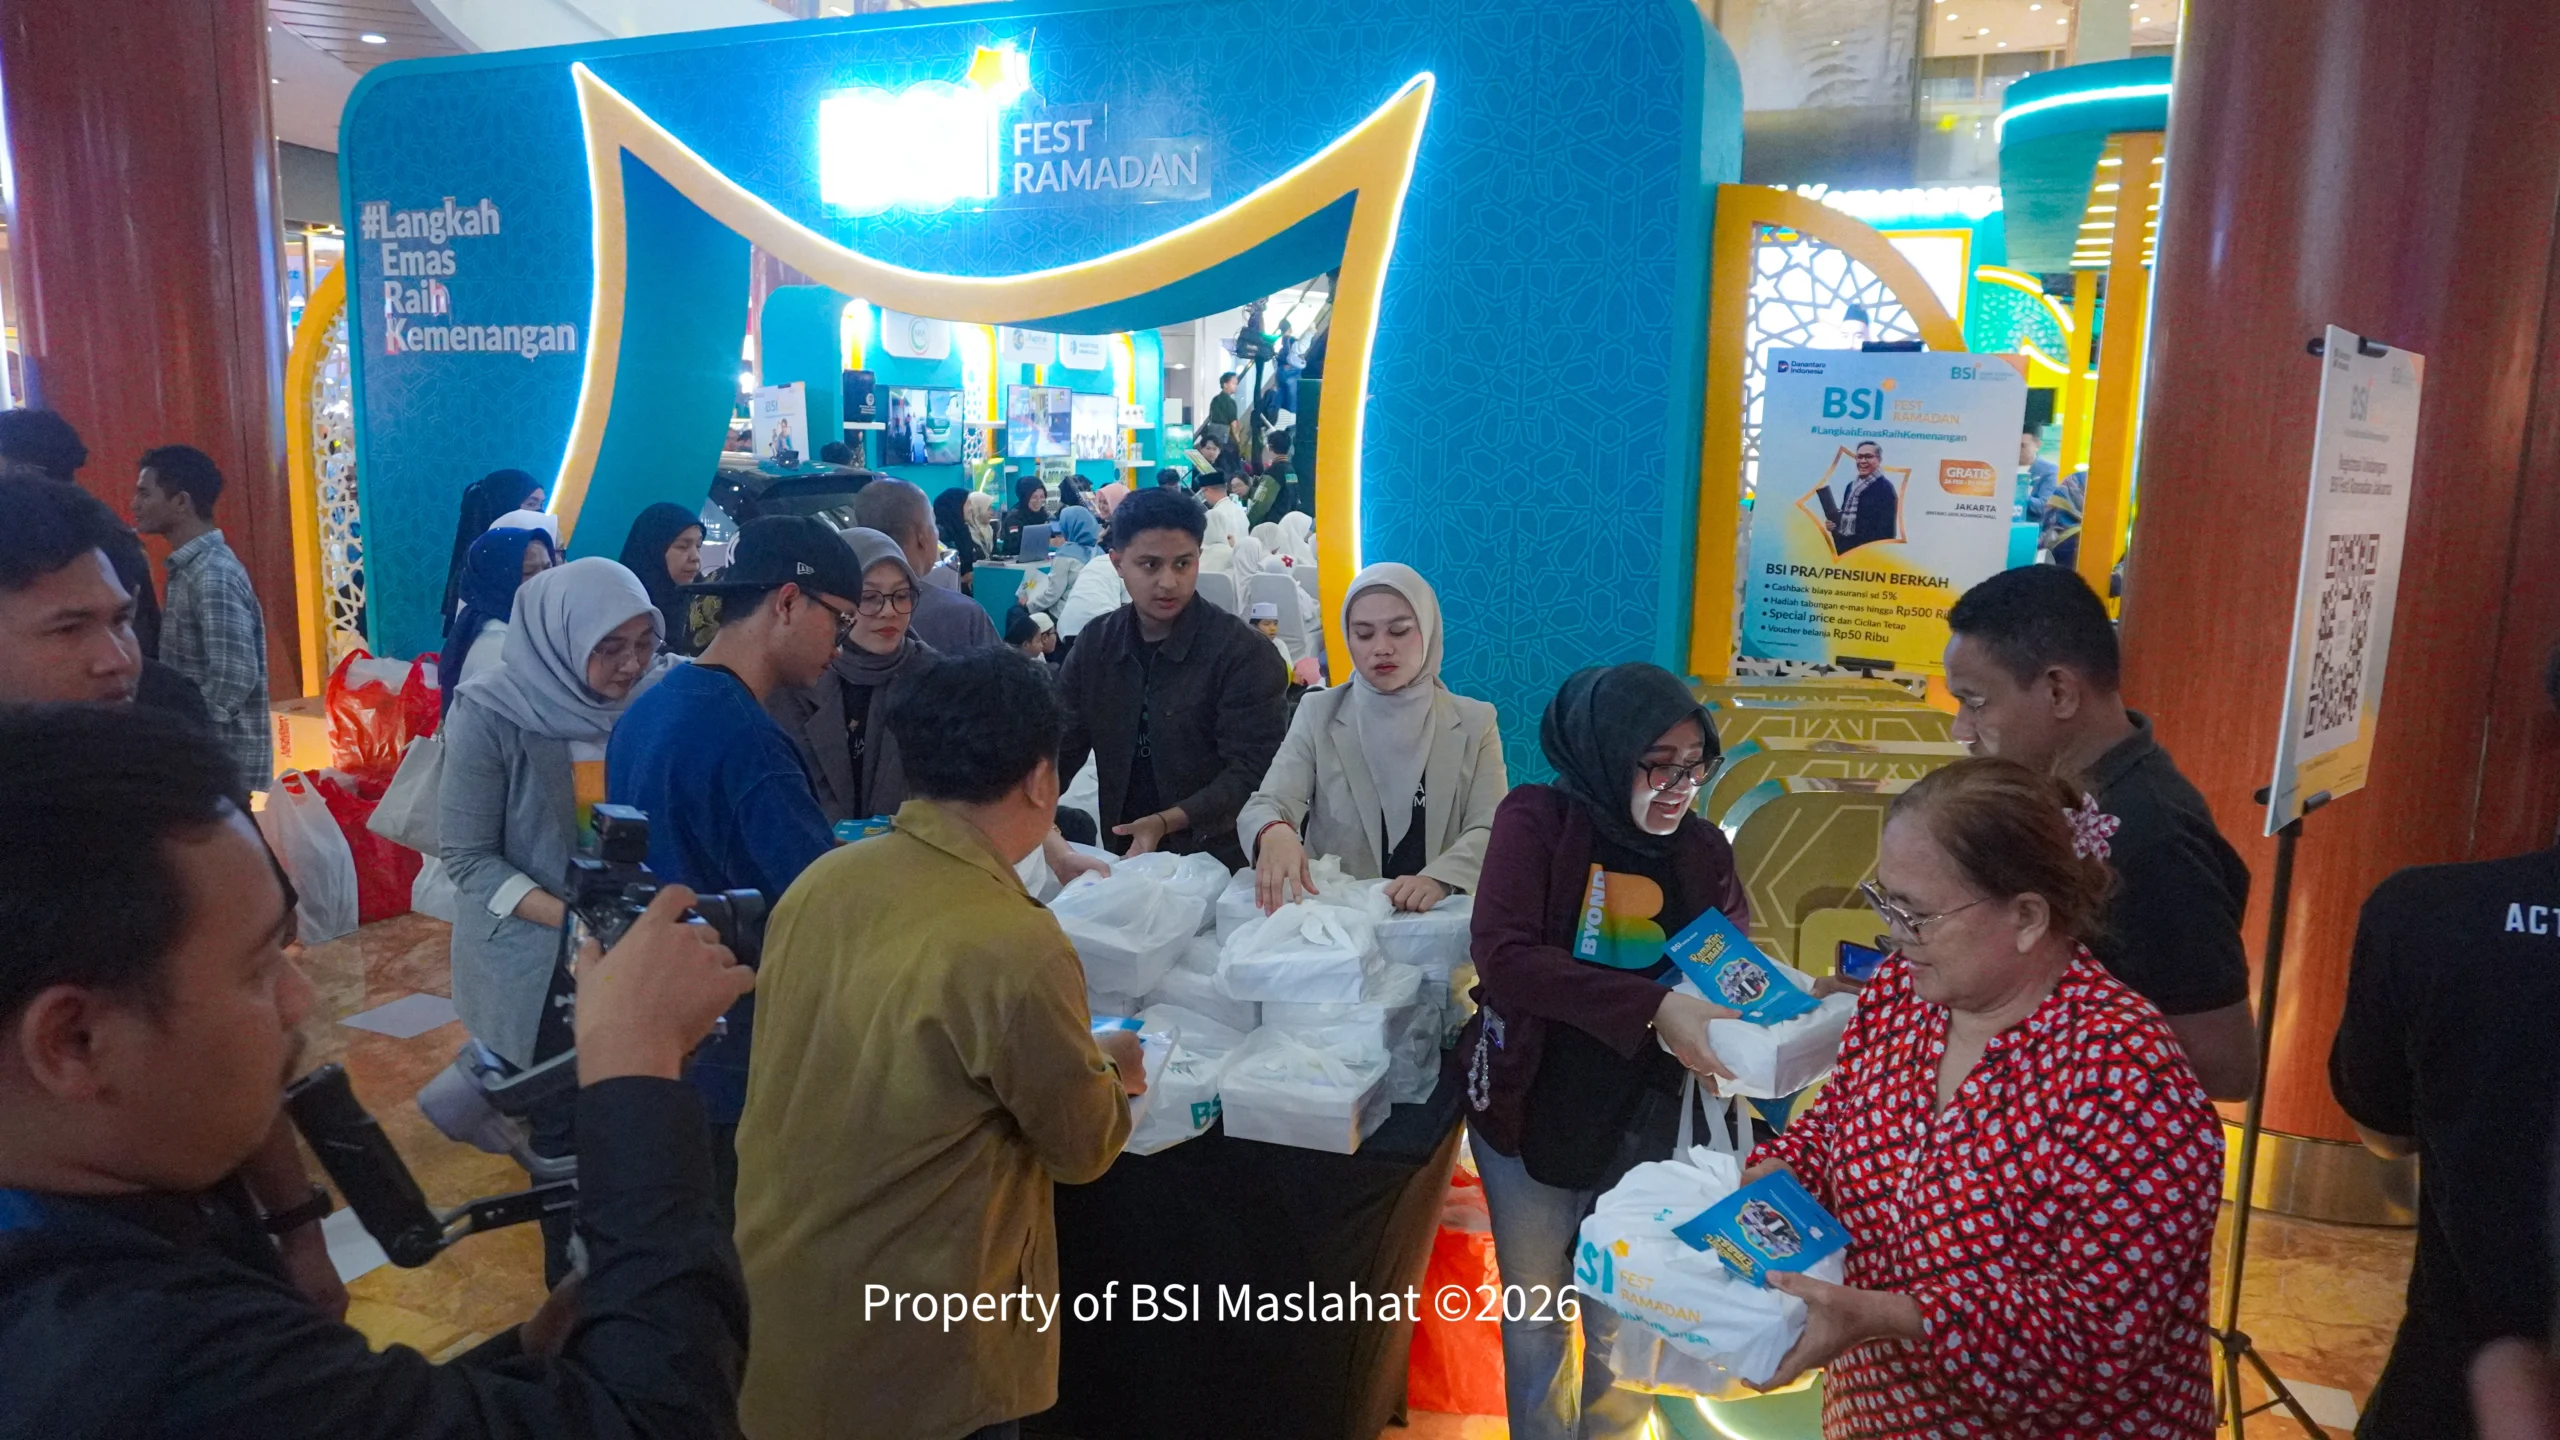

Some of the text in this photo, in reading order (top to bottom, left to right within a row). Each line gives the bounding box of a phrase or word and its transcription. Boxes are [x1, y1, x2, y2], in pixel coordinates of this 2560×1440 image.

[1014, 119, 1092, 156] FEST
[1014, 147, 1198, 195] RAMADAN
[361, 196, 501, 245] #Langkah
[382, 243, 457, 276] Emas
[384, 279, 448, 316] Raih
[386, 318, 578, 359] Kemenangan
[1790, 367, 1824, 375] Indonesia
[1951, 366, 1977, 380] BSI
[1823, 386, 1884, 421] BSI
[1894, 399, 1923, 411] FEST
[1893, 411, 1960, 424] RAMADAN
[1811, 425, 1968, 443] #LangkahEmasRaihKemenangan
[1946, 466, 1992, 480] GRATIS
[1955, 503, 1997, 513] JAKARTA
[1766, 563, 1949, 589] BSI PRA/PENSIUN BERKAH
[1772, 583, 1898, 601] Cashback biaya asuransi sd 5%
[1769, 608, 1907, 631] Special price dan Cicilan Tetap
[1770, 597, 1799, 606] Hadiah
[1801, 600, 1838, 611] tabungan
[1840, 604, 1864, 613] e-mas
[1866, 606, 1894, 615] hingga
[1896, 605, 1933, 618] Rp500
[1768, 624, 1890, 643] Voucher belanja Rp50 Ribu
[1581, 870, 1605, 956] BYOND
[1576, 1235, 1613, 1294] SI
[1620, 1269, 1654, 1293] FEST
[1620, 1288, 1702, 1324] RAMADAN
